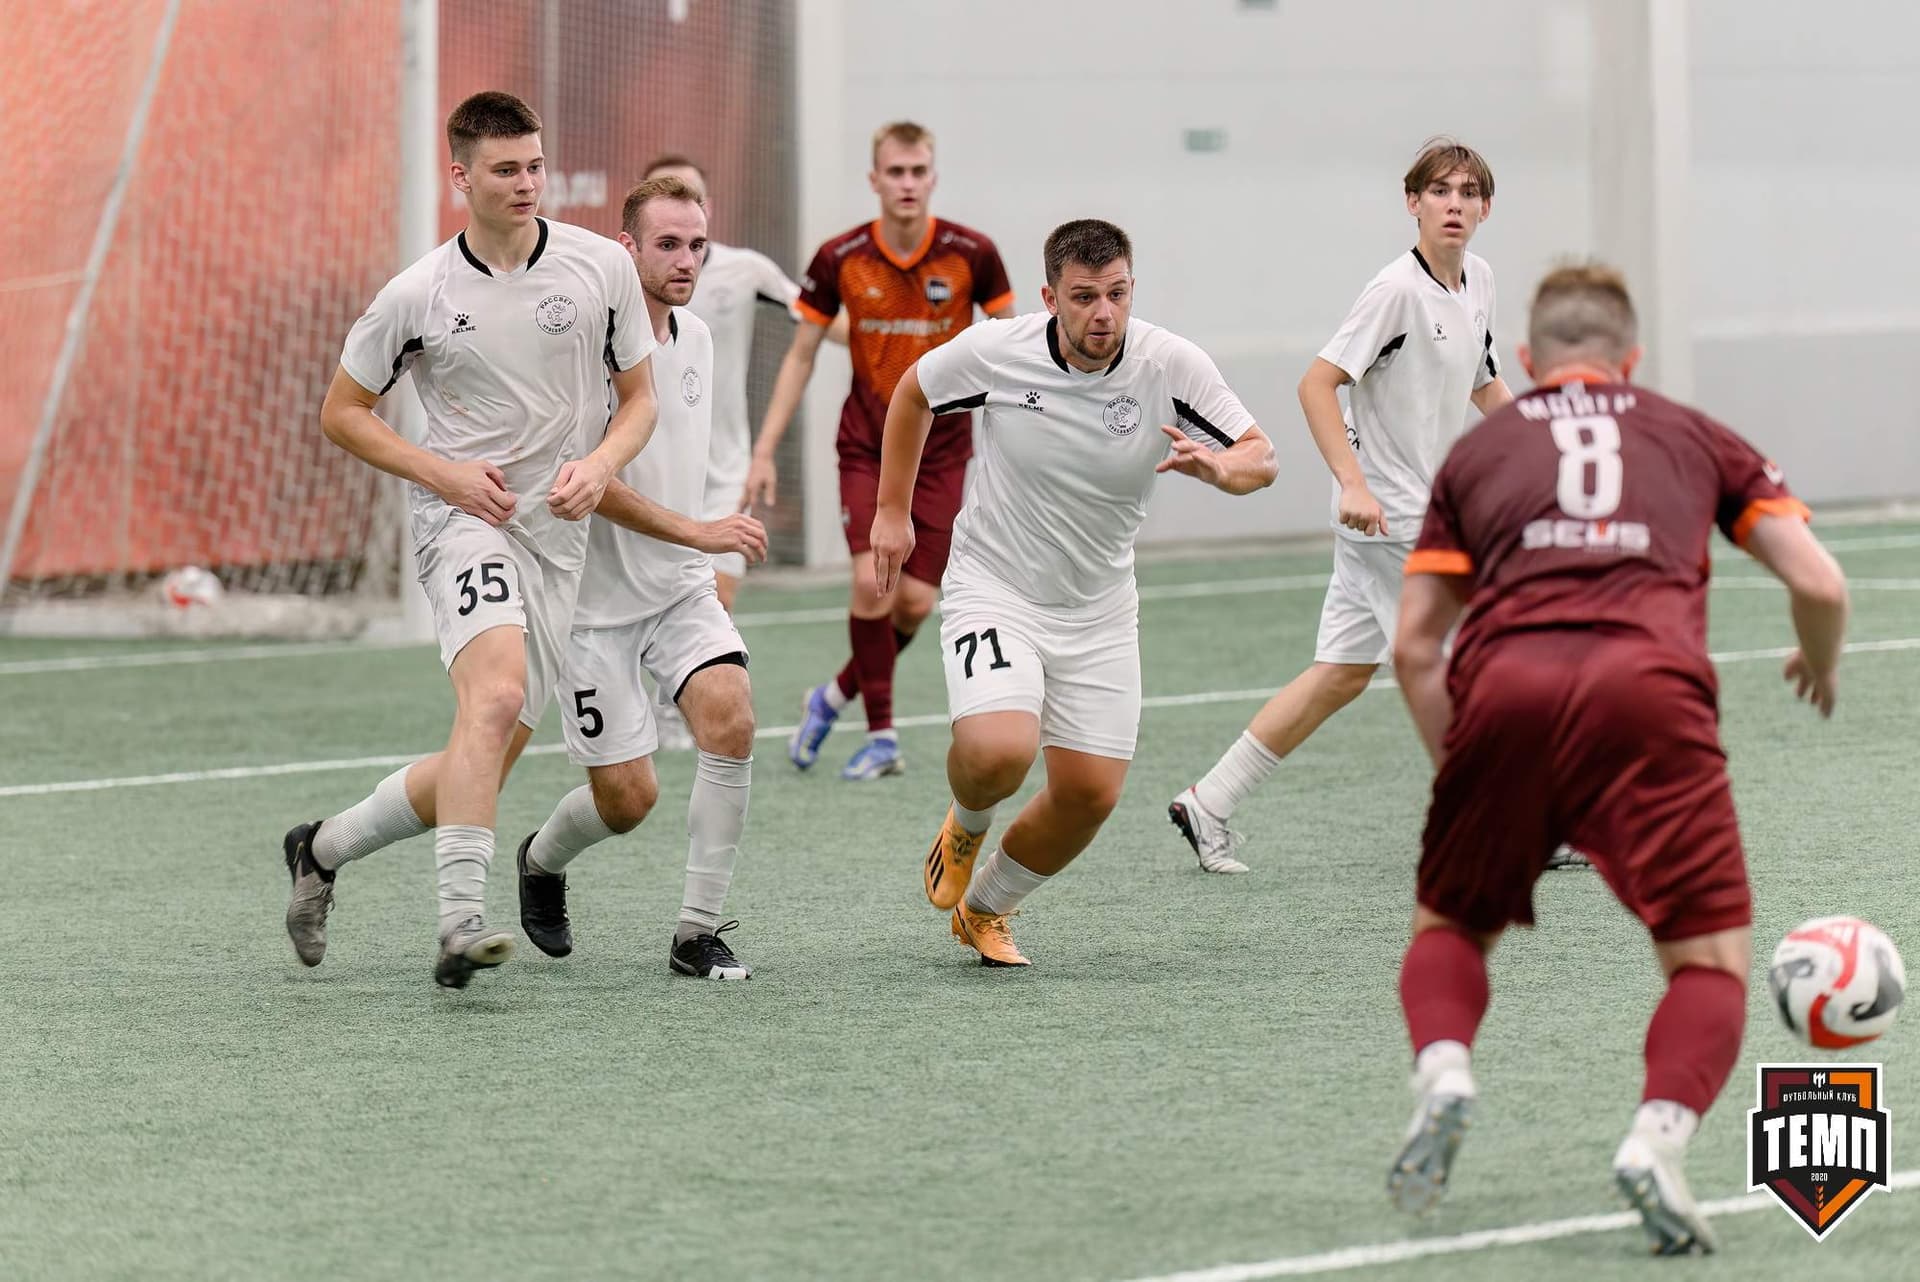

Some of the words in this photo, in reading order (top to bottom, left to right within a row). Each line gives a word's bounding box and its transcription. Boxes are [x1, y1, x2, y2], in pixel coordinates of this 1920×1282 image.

[540, 296, 572, 309] РАССВЕТ
[451, 325, 477, 335] KELME
[1018, 403, 1045, 412] KELME
[1107, 397, 1138, 409] РАССВЕТ
[1550, 415, 1624, 519] 8
[455, 562, 510, 617] 35
[954, 627, 1012, 679] 71
[574, 688, 604, 739] 5
